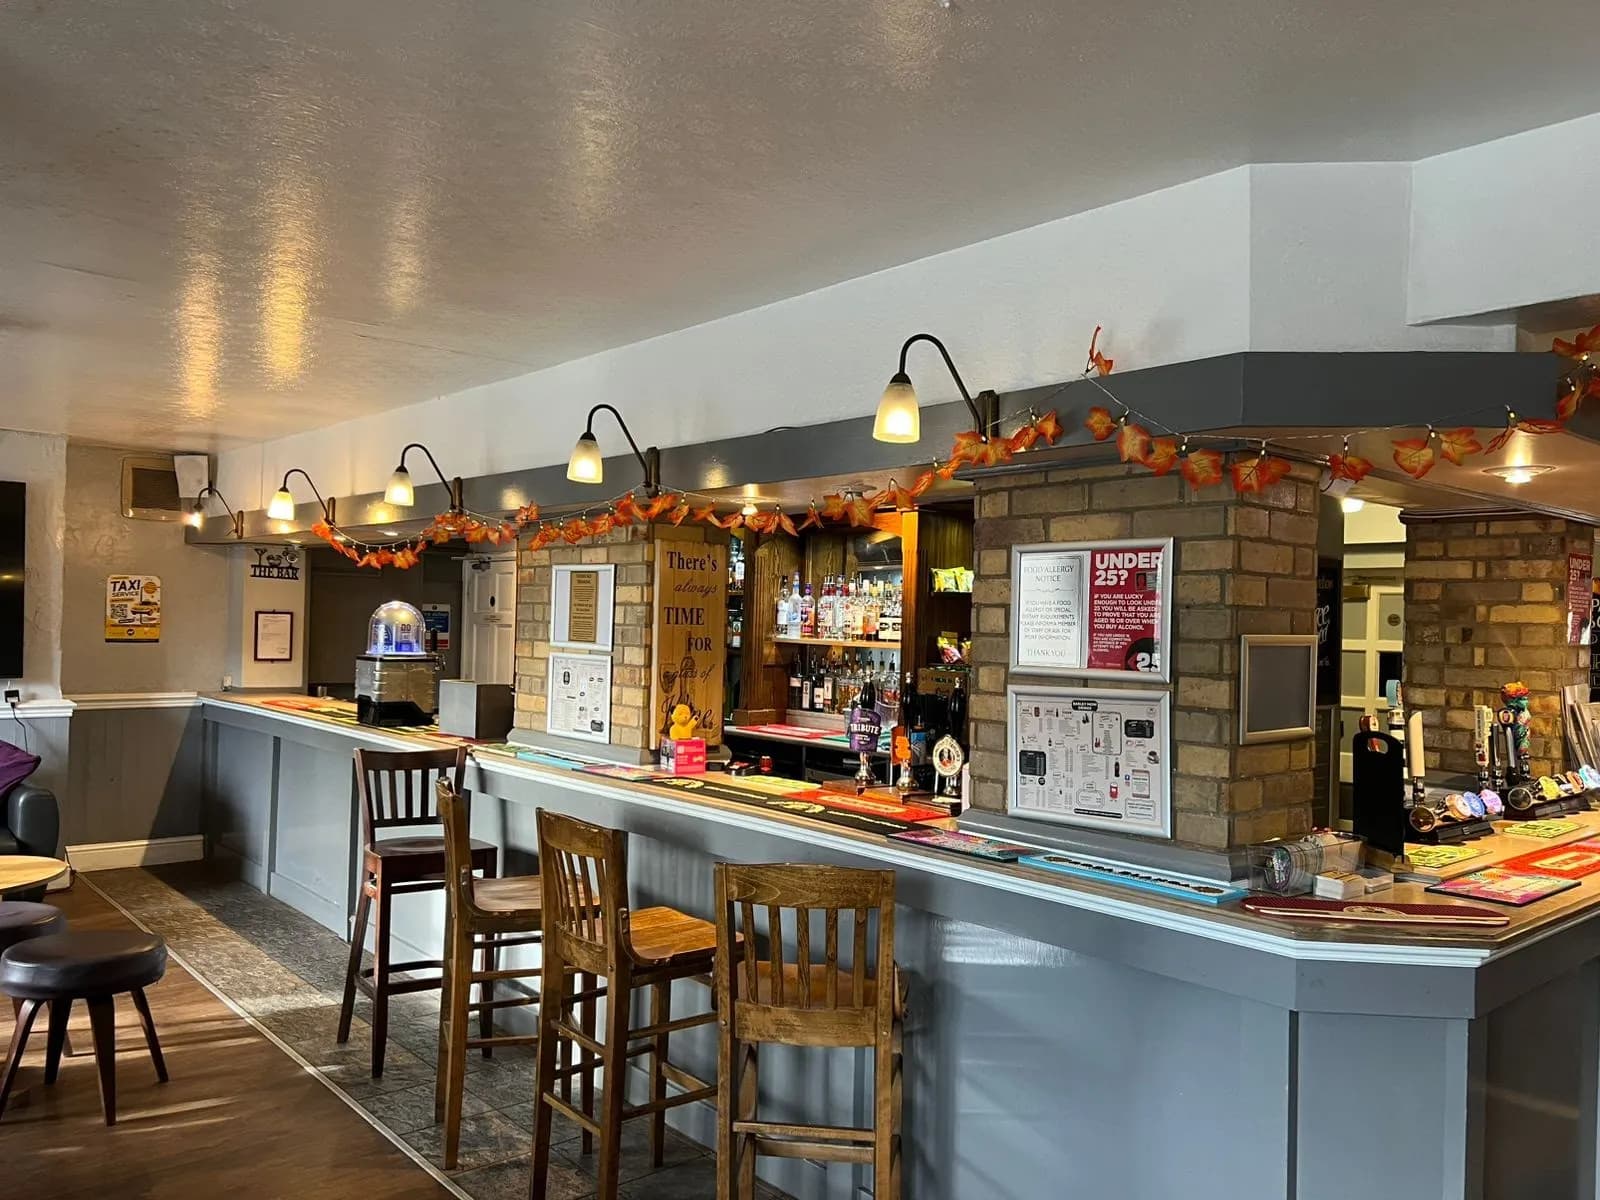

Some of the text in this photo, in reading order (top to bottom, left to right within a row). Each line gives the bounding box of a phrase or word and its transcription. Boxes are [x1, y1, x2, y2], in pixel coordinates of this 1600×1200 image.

[666, 551, 718, 572] There's
[1095, 552, 1162, 569] UNDER
[1570, 557, 1591, 571] UNDER
[253, 565, 299, 580] THE BAR
[1094, 569, 1128, 586] 25?
[110, 580, 141, 591] TAXI
[674, 579, 718, 597] always
[664, 606, 705, 625] TIME
[687, 637, 712, 651] FOR
[1136, 652, 1160, 673] 25
[700, 663, 715, 683] of
[850, 723, 879, 734] TRIBUTE
